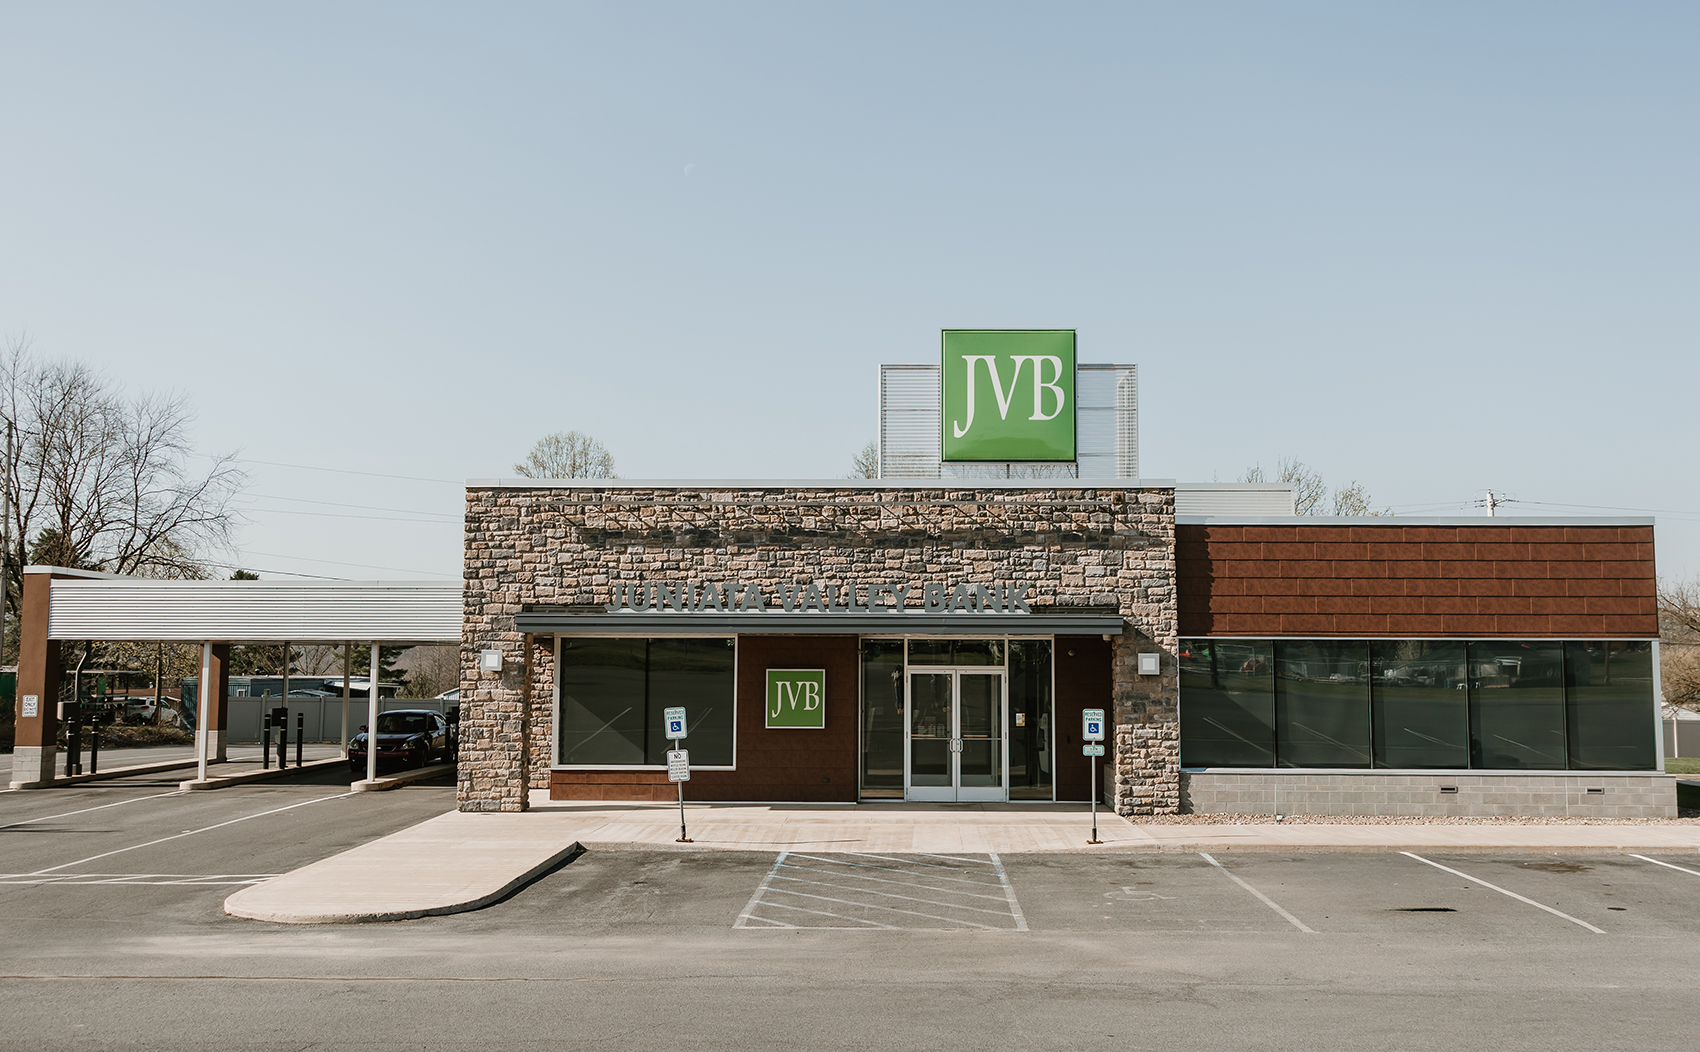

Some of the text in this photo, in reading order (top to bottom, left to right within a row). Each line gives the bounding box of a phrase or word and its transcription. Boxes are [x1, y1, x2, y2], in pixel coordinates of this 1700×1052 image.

[953, 355, 1065, 438] JVB
[604, 583, 1032, 613] JUNIATA VALLEY BANK
[772, 681, 820, 718] JVB
